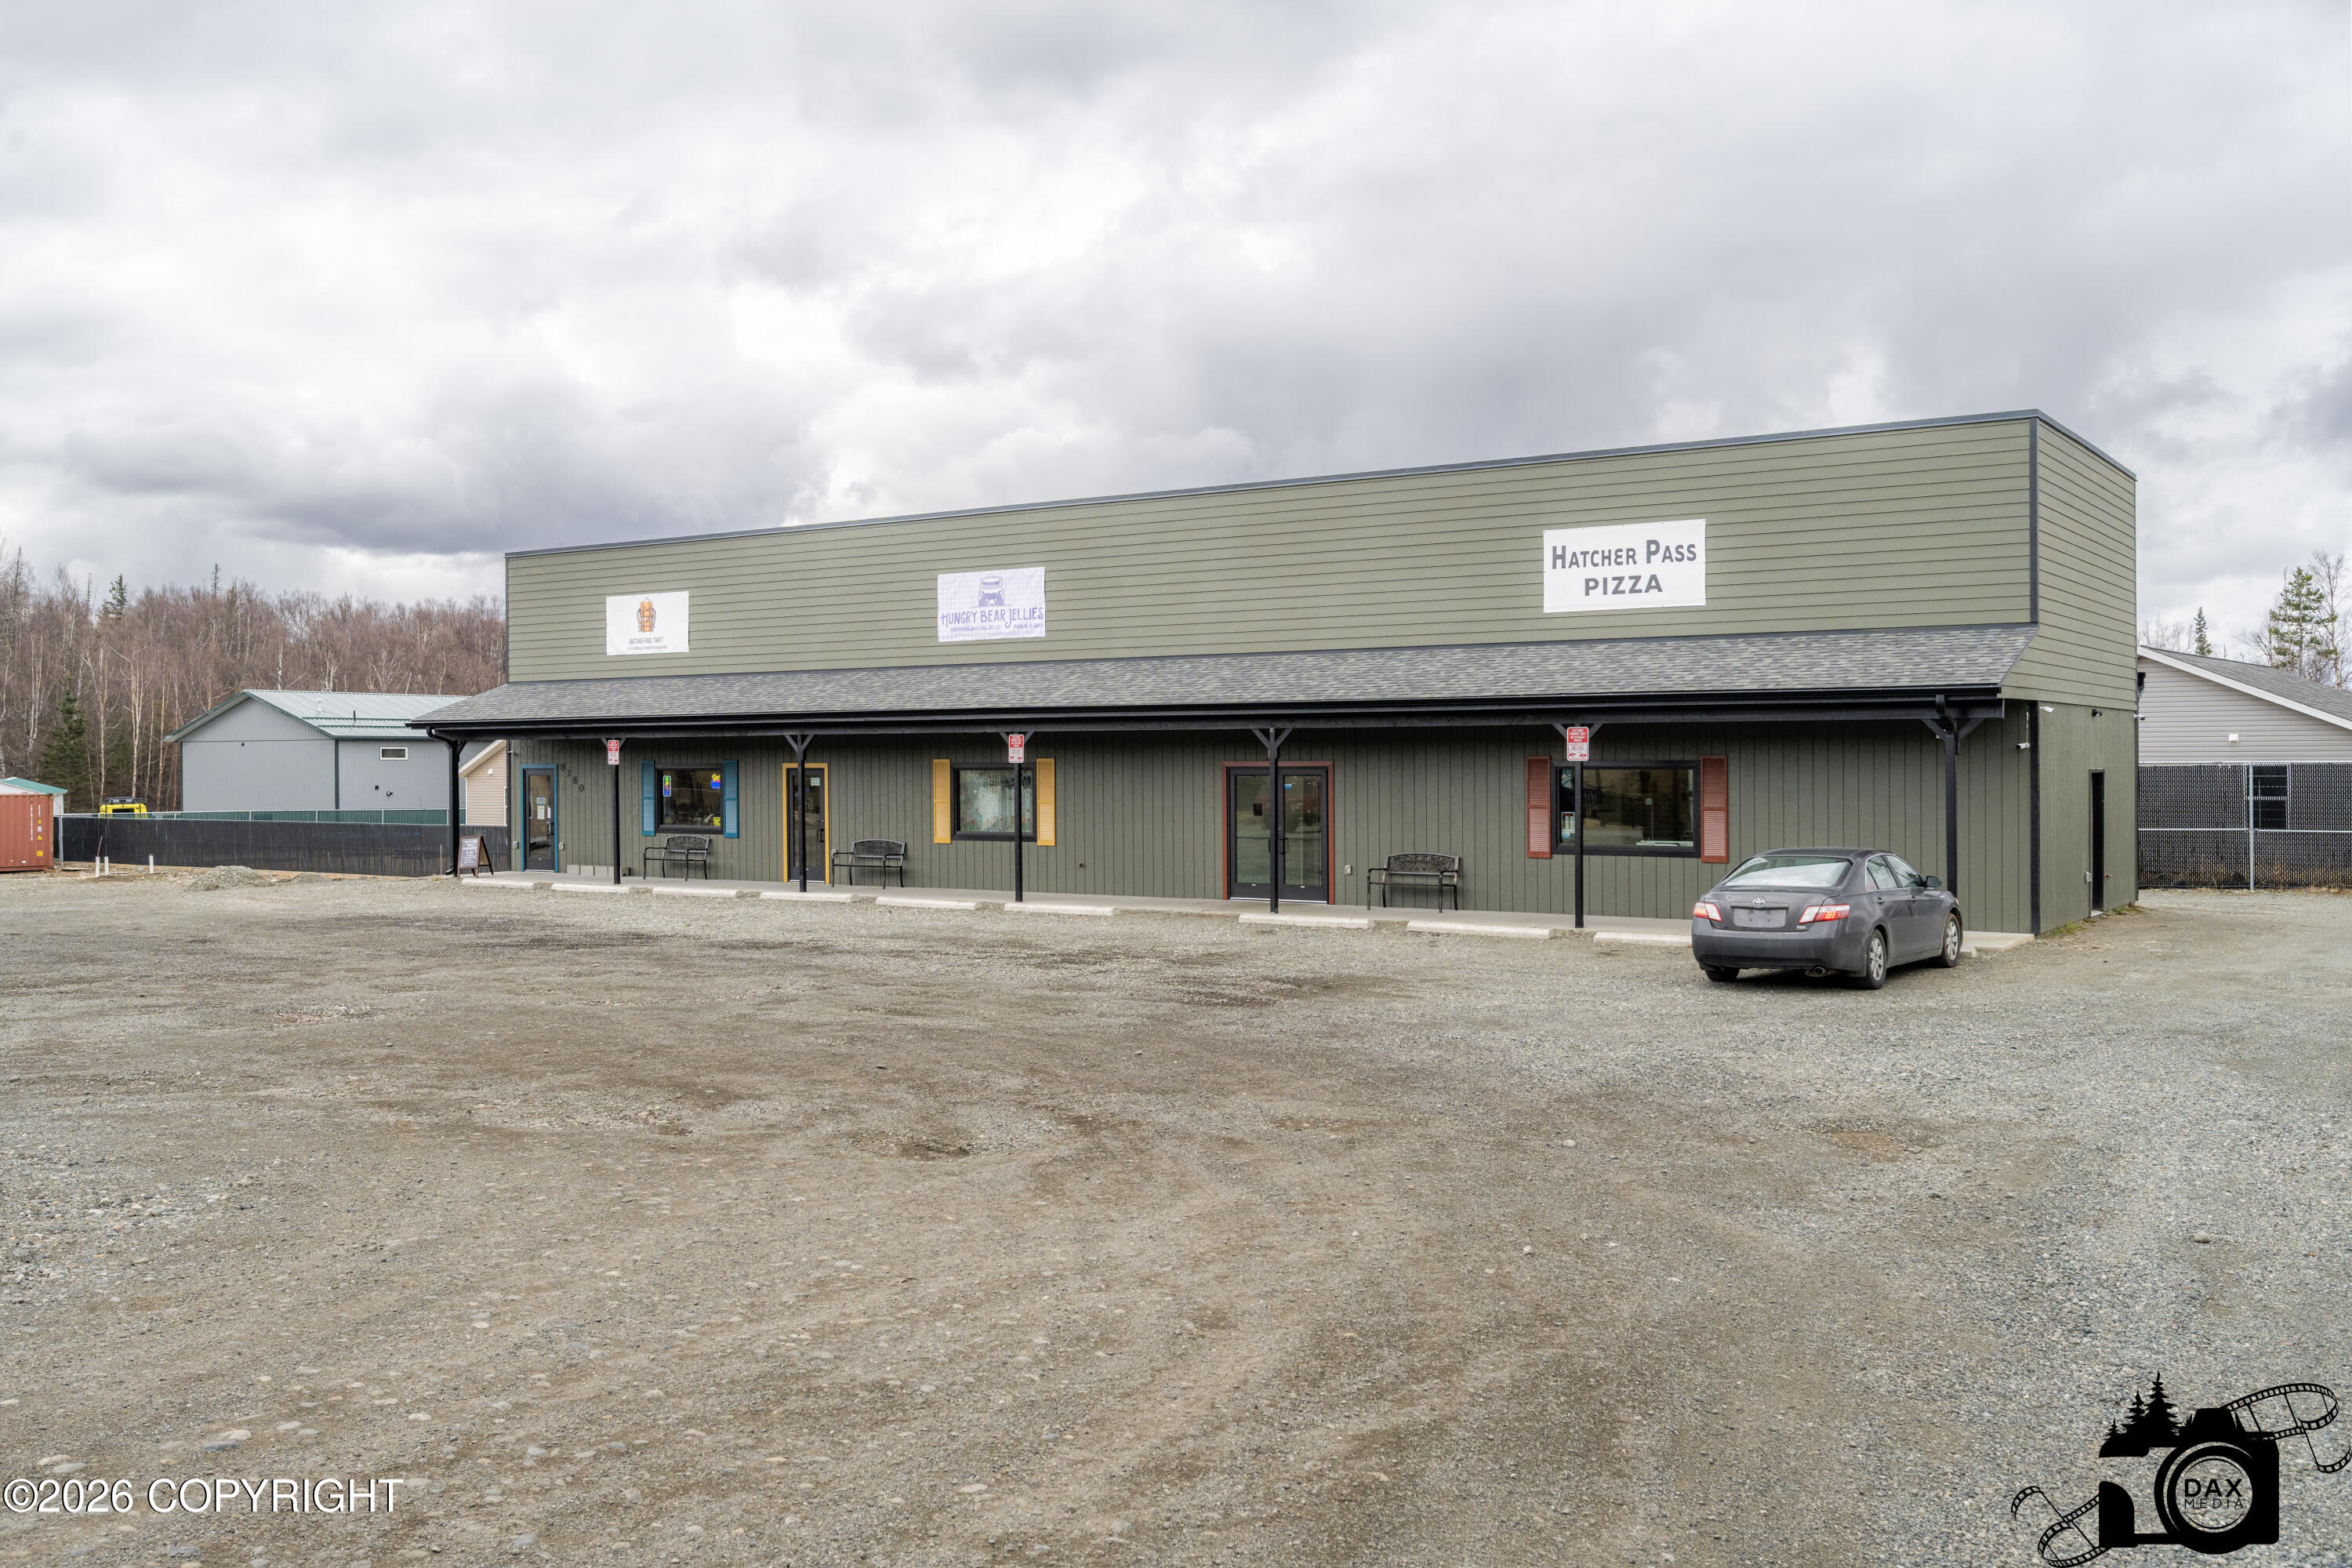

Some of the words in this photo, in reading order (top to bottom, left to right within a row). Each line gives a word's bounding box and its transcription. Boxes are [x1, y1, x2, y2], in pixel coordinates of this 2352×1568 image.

[1552, 546, 1637, 569] HATCHER
[1646, 539, 1697, 564] PASS
[1584, 574, 1663, 596] PIZZA
[939, 610, 978, 627] HUNGRY
[980, 609, 1006, 623] BEAR
[1004, 607, 1044, 628] JELLIES
[560, 763, 585, 793] 8380
